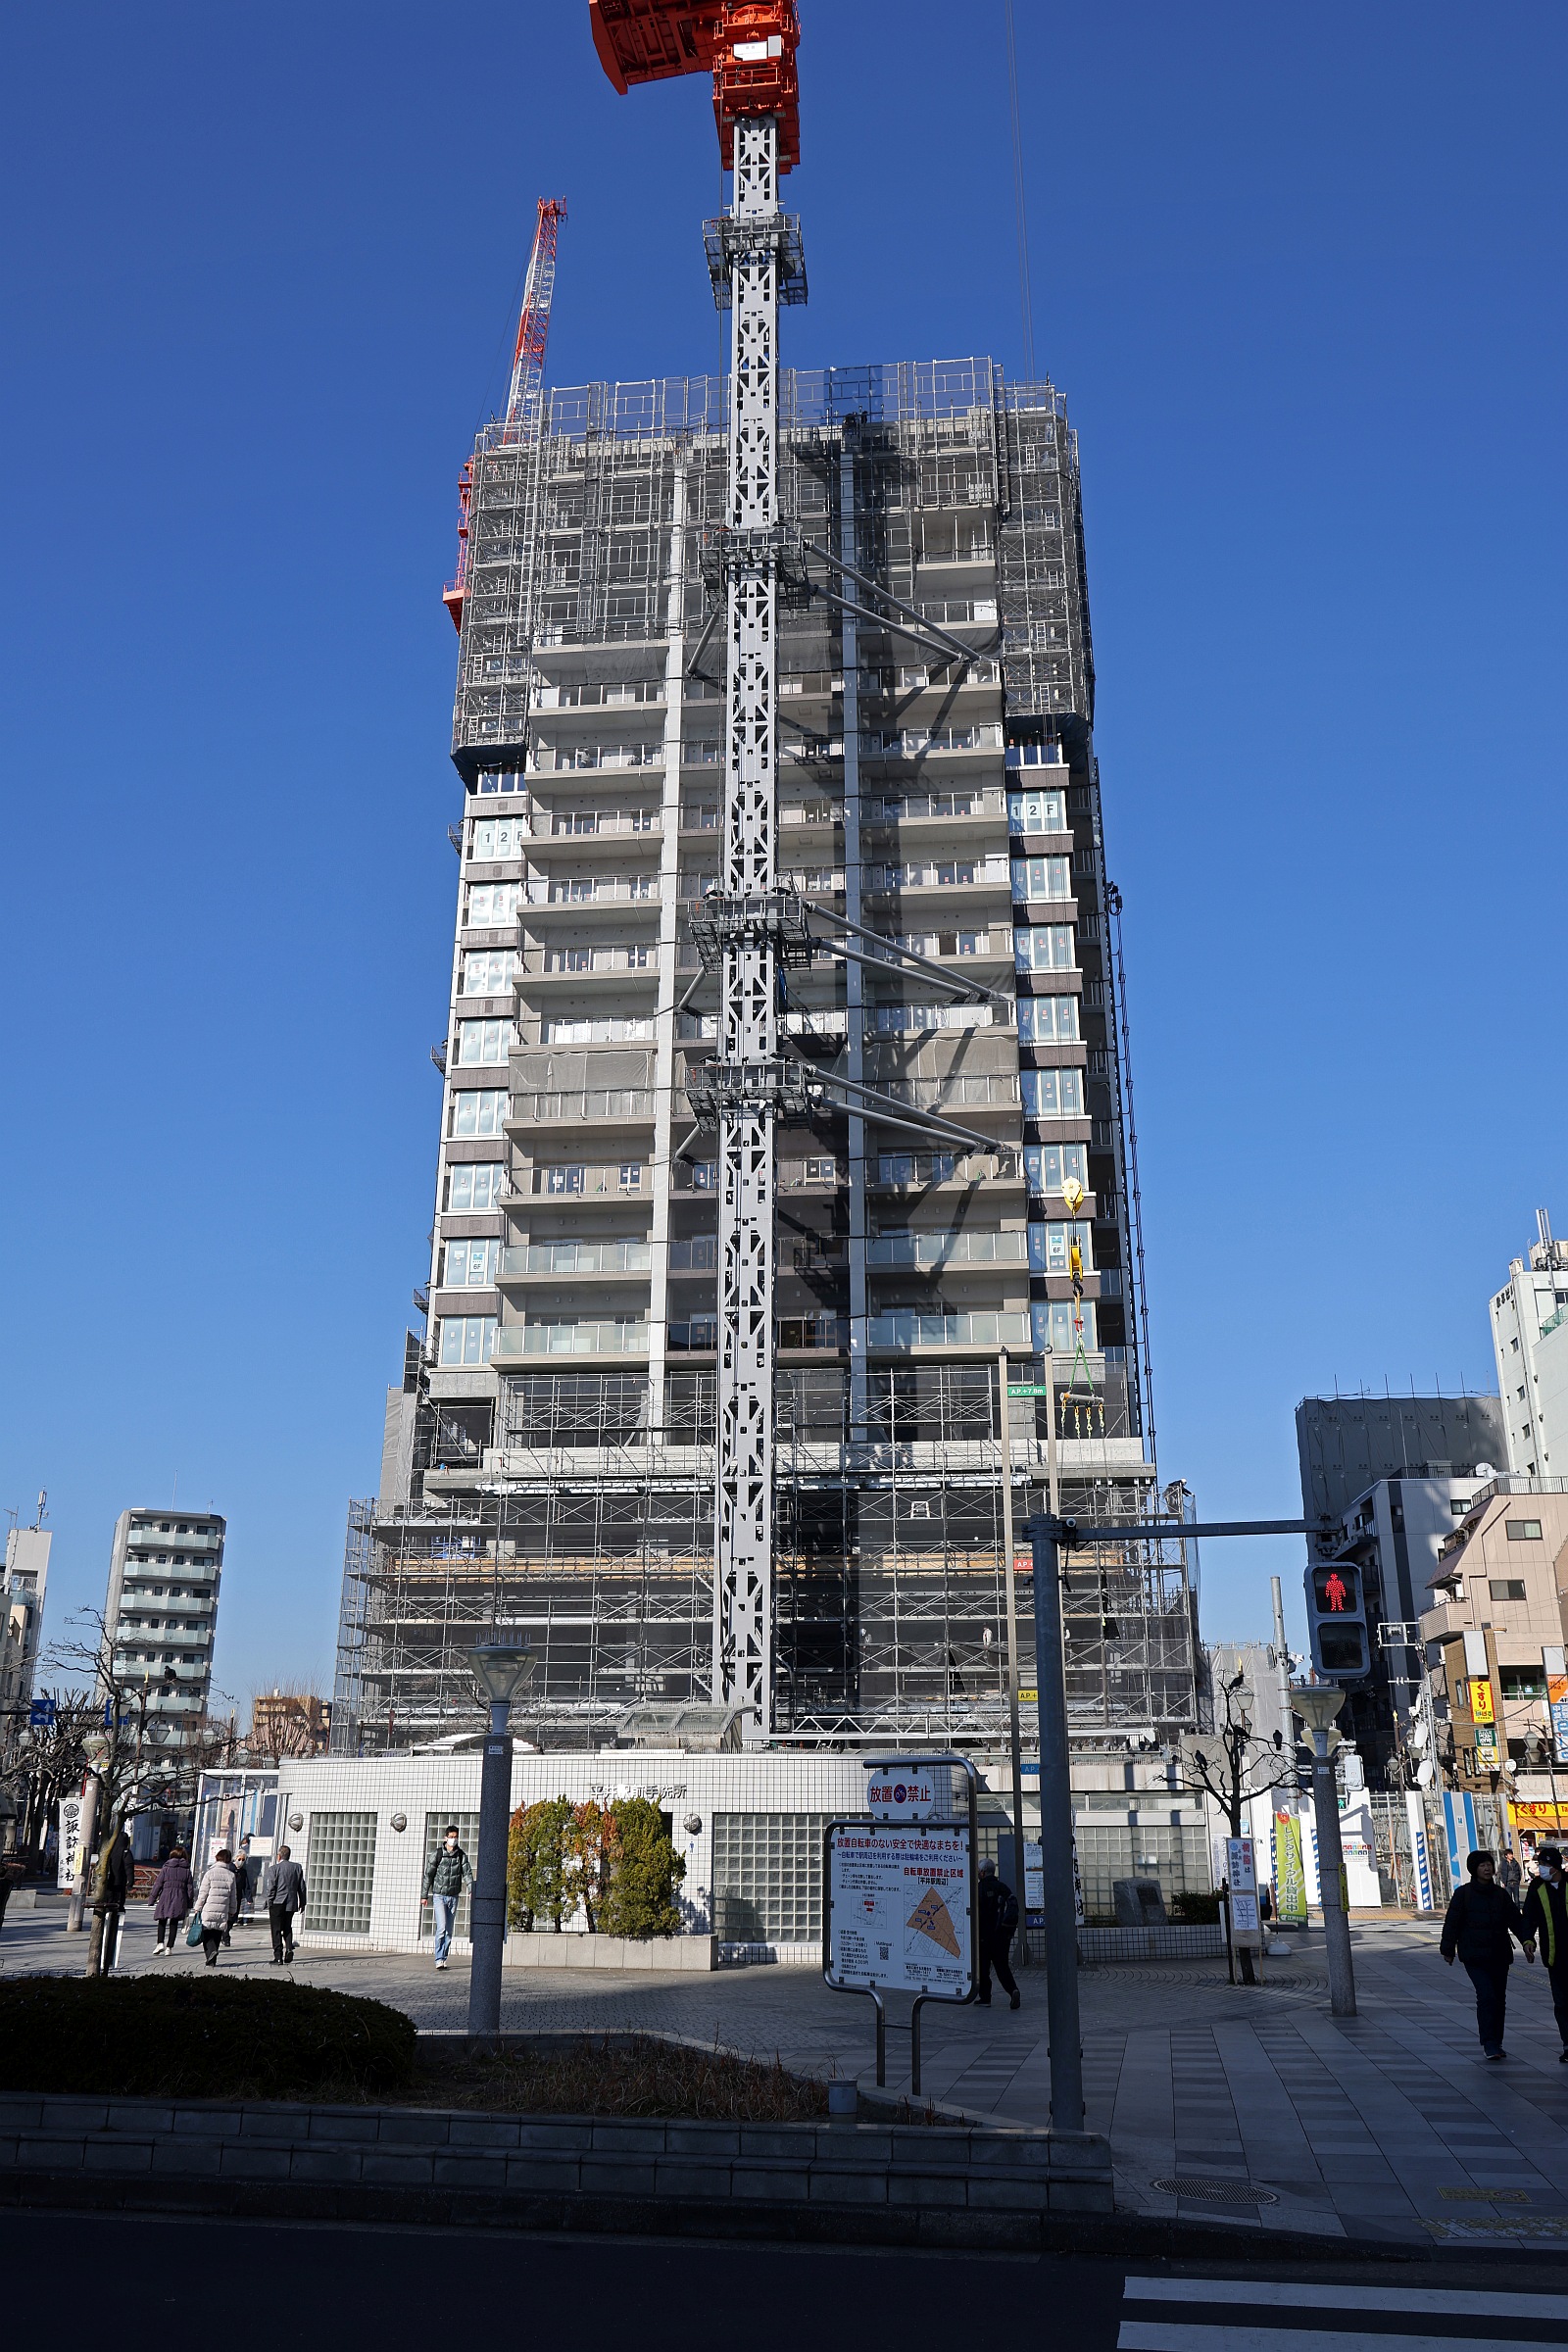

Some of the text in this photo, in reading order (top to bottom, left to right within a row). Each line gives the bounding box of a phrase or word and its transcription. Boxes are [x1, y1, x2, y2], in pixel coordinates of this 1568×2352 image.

[1477, 1683, 1487, 1710] くすり
[1520, 1803, 1547, 1815] くすり
[1284, 1826, 1298, 1913] レンタサイクル貸出中
